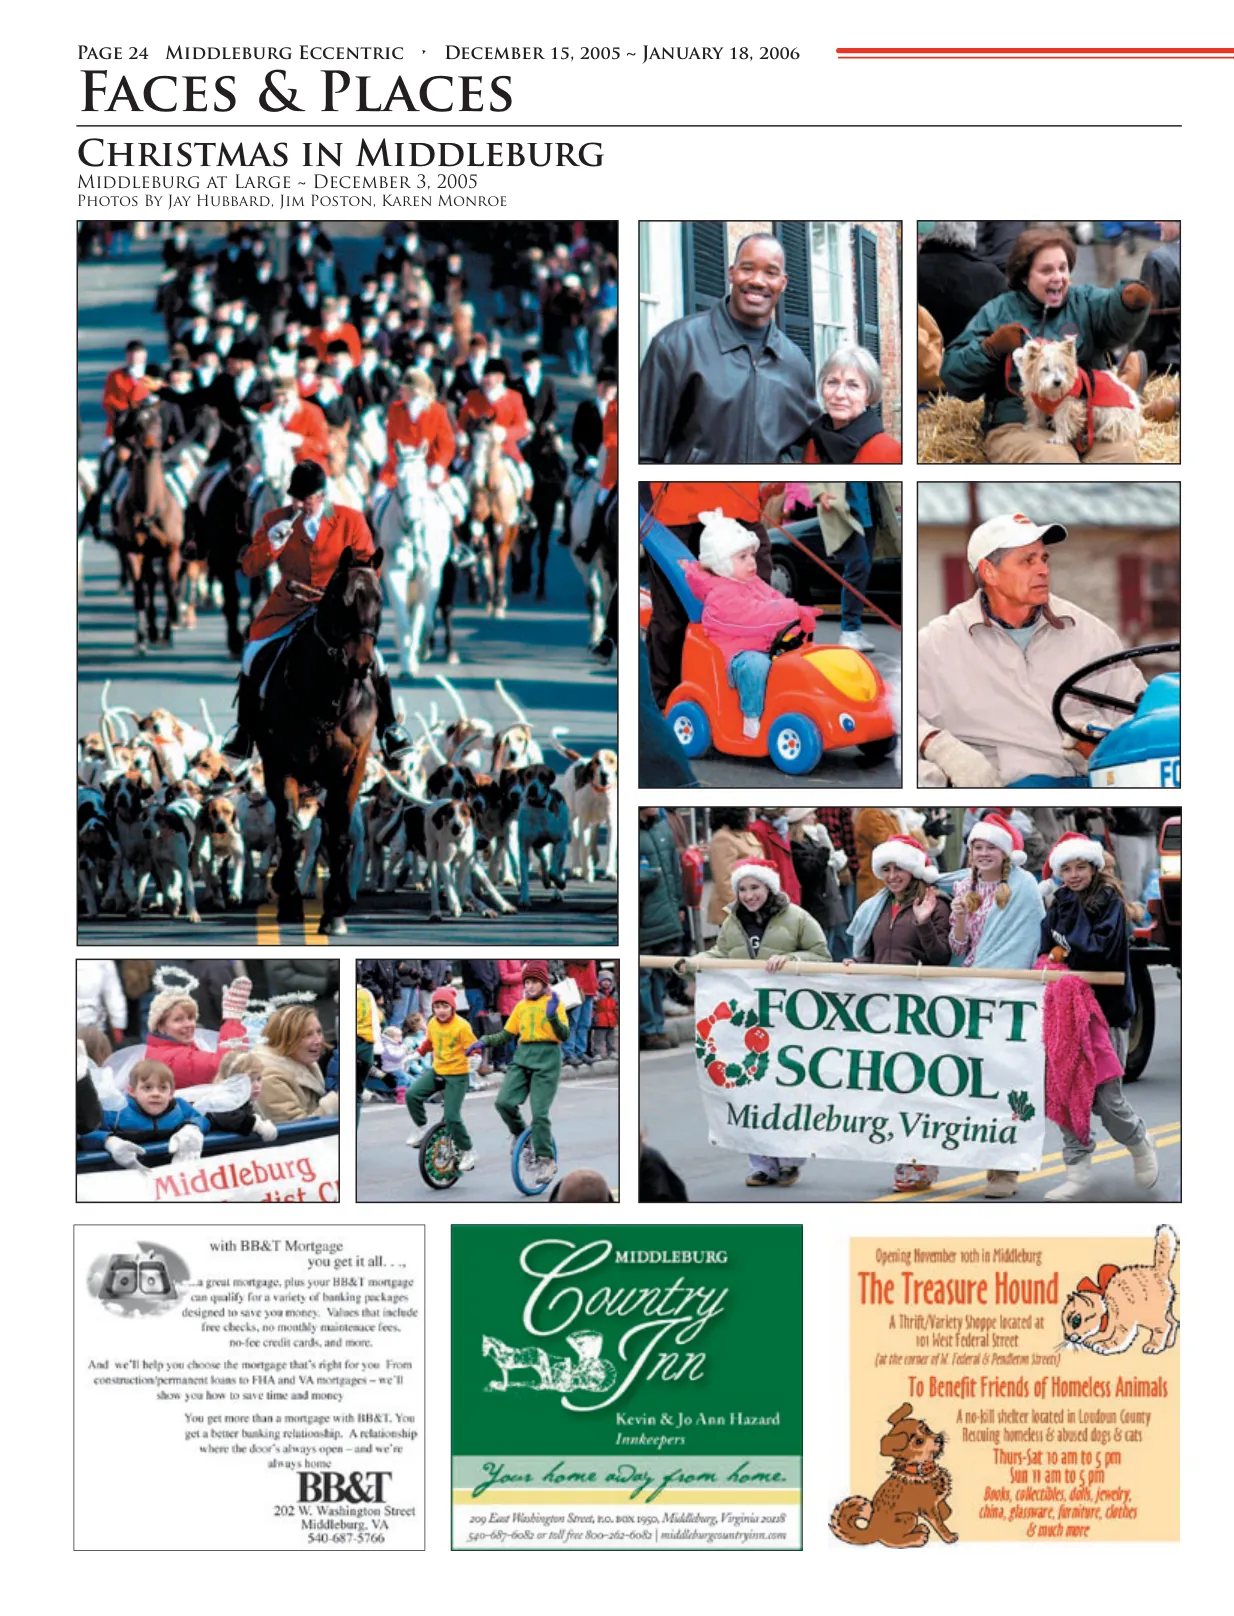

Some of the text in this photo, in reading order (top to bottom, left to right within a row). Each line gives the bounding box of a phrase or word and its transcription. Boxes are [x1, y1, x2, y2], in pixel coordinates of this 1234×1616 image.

[129, 47, 148, 59] 24
[552, 47, 573, 61] 15,
[581, 47, 620, 59] 2005
[731, 47, 752, 60] 18,
[760, 47, 800, 59] 2006
[259, 70, 305, 112] &
[417, 174, 430, 189] 3,
[437, 174, 477, 188] 2005
[754, 988, 1037, 1043] FOXCROFT
[776, 1044, 1000, 1100] SCHOOL
[727, 1102, 1018, 1150] Middleburg, Virginia
[155, 1157, 317, 1200] Middleburg
[210, 1240, 343, 1254] with BB&T Mortgage
[616, 1251, 728, 1263] MIDDLEBURG
[519, 1239, 729, 1345] Country
[858, 1272, 1058, 1305] The Treasure Hound
[561, 1317, 704, 1411] Inn
[908, 1376, 1168, 1399] To Benefit Friends of Homeless Animals
[616, 1412, 781, 1429] Kevin & Jo Ann Hazard
[616, 1433, 685, 1449] Innkeepers
[297, 1471, 392, 1504] BB&T
[471, 1461, 787, 1503] Your home away from home.
[274, 1505, 415, 1518] 202 W. Washington Street
[302, 1519, 389, 1531] Middleburg, VA
[308, 1533, 385, 1543] 540-687-5766
